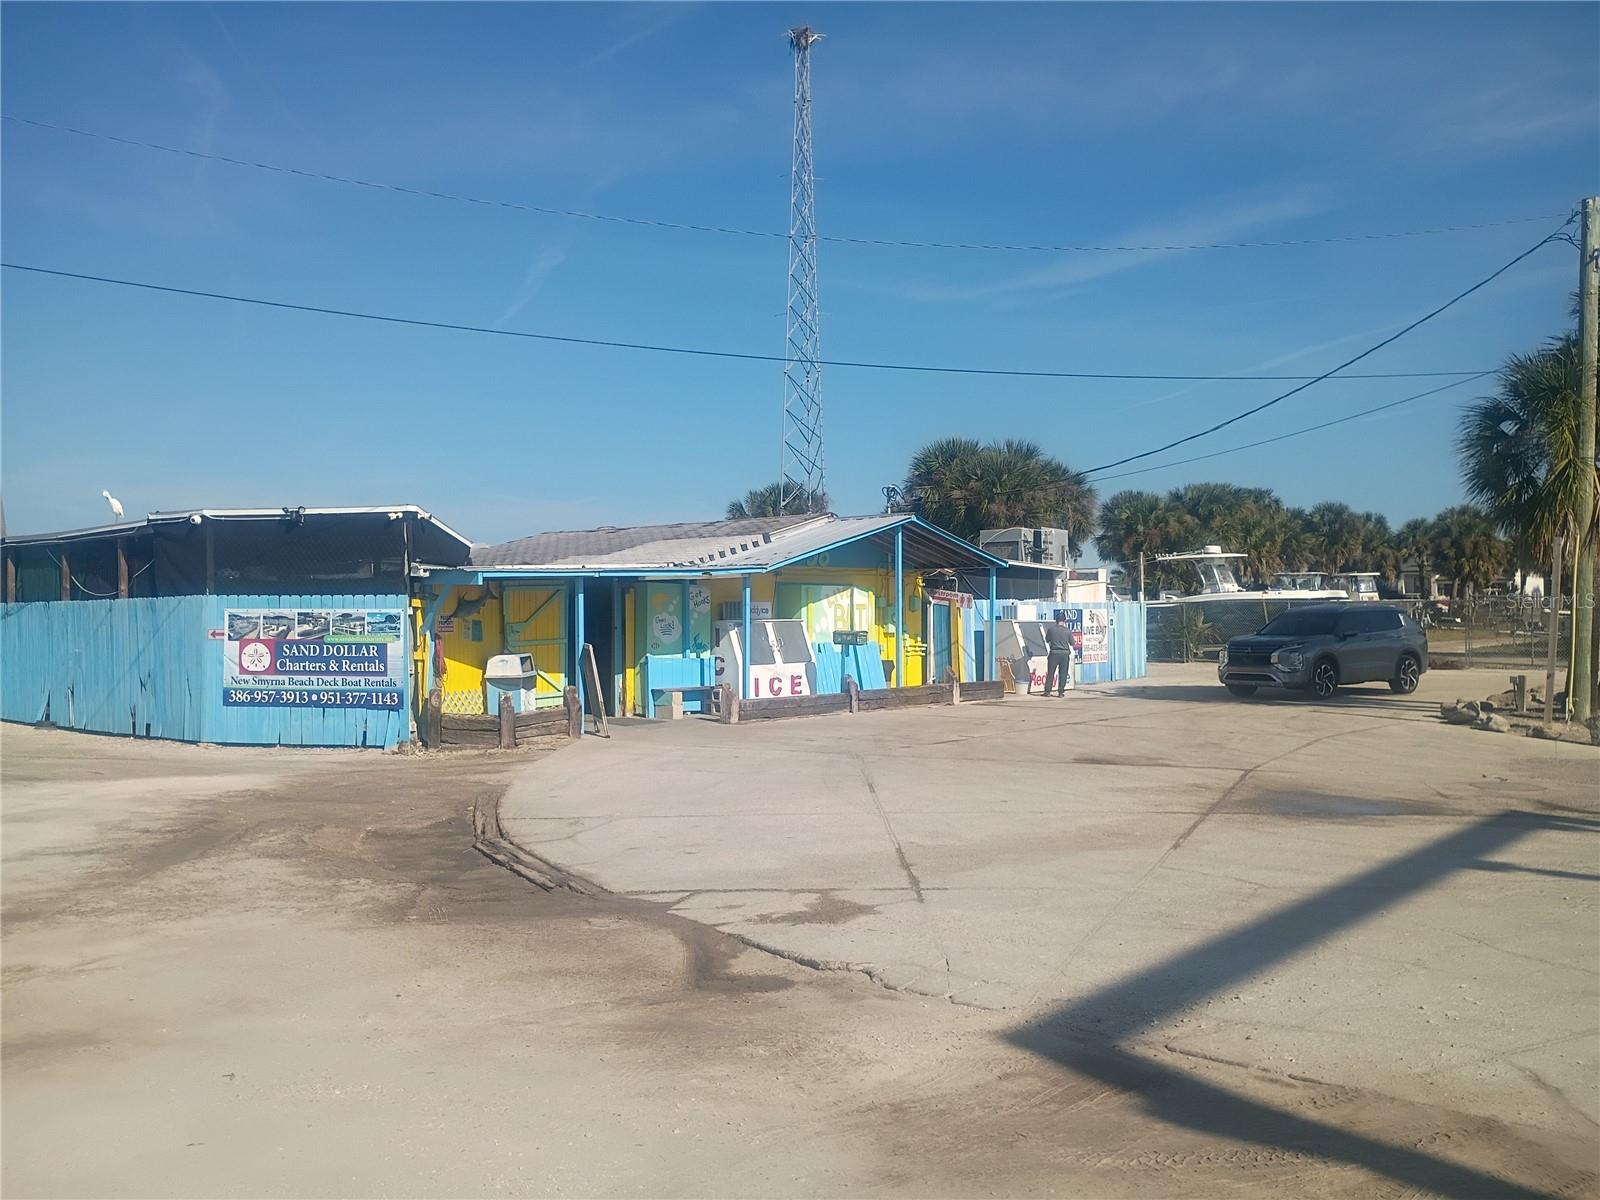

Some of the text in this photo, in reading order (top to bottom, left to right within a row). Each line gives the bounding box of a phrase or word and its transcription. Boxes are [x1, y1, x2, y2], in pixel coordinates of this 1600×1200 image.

[1083, 626, 1095, 636] LIVE
[282, 644, 379, 657] SAND DOLLAR
[276, 658, 385, 672] Charters & Rentals
[231, 676, 397, 689] New Smyrna Beach Deck Boat Rentals
[754, 674, 803, 698] ICE
[229, 689, 399, 706] 386-957-3913 951-377-1143
